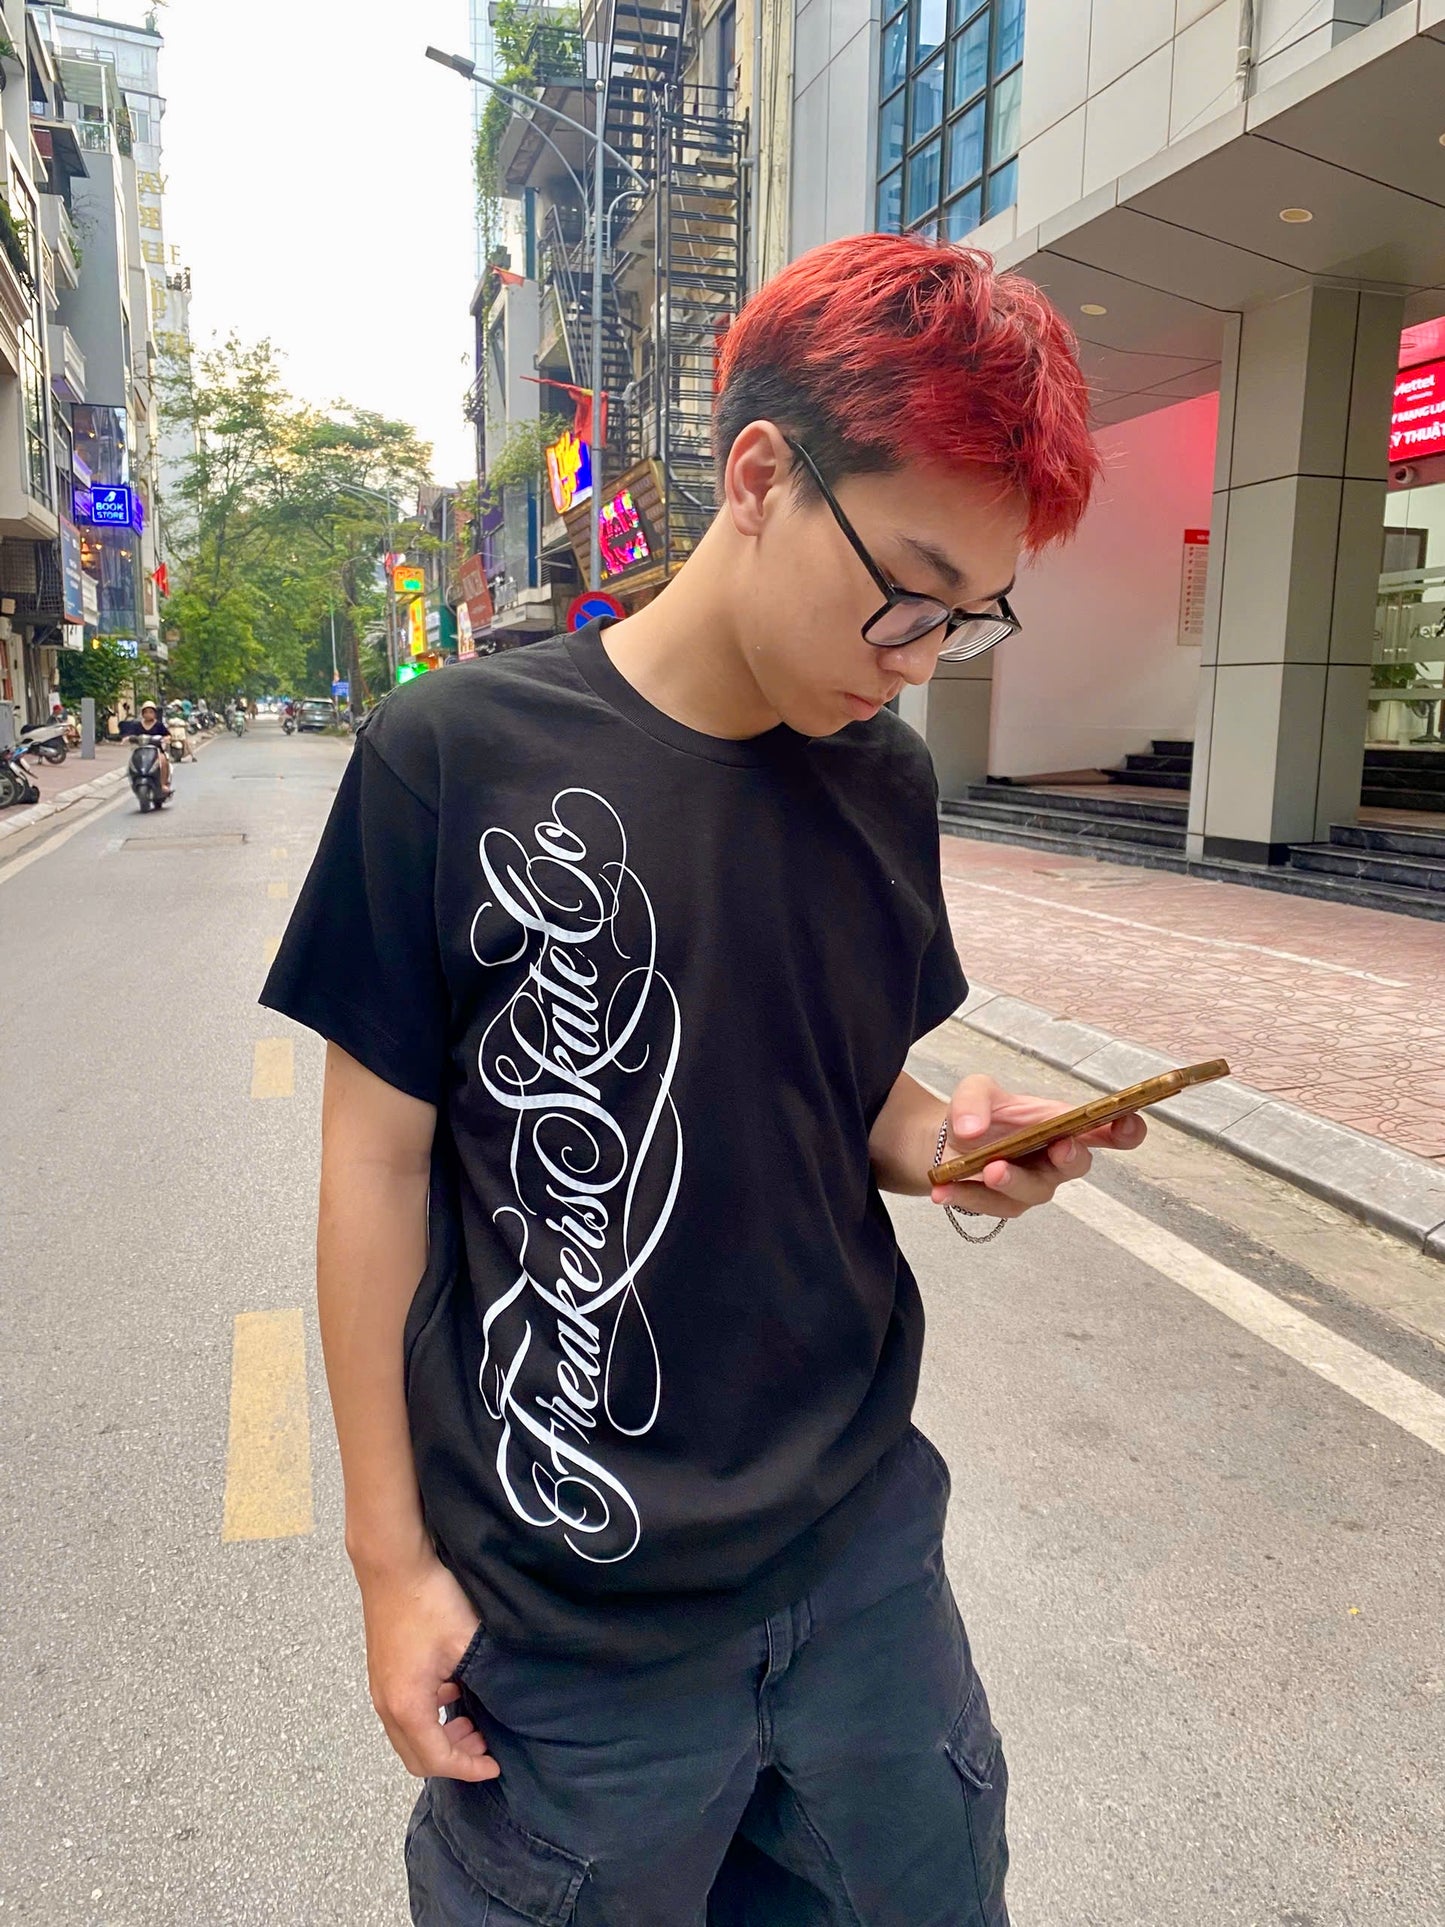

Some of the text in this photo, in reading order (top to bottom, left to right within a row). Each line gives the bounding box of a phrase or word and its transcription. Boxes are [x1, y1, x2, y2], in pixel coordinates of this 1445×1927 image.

[96, 502, 124, 511] BOOK
[97, 511, 125, 520] STORE
[470, 787, 650, 1563] Freakers Skate Co
